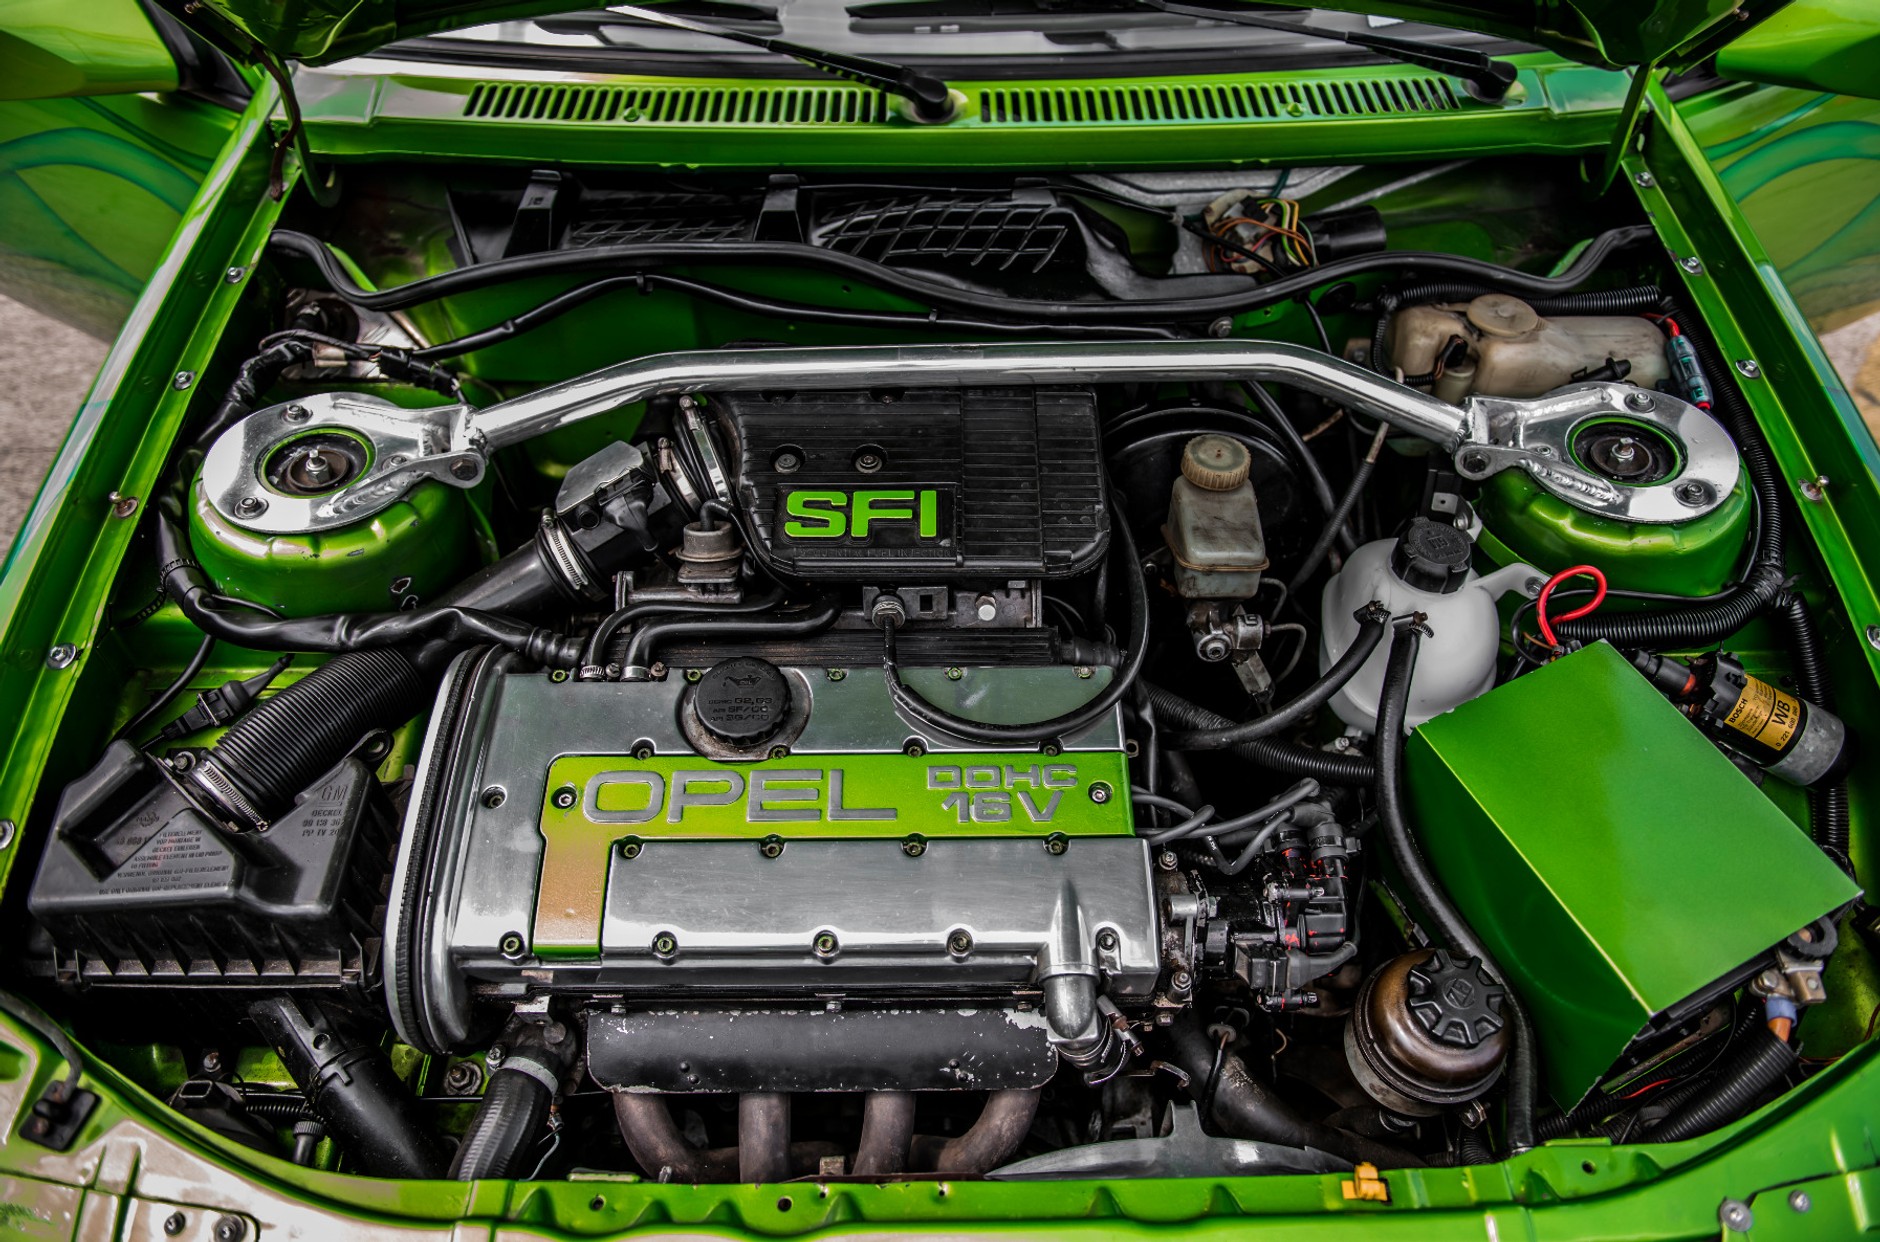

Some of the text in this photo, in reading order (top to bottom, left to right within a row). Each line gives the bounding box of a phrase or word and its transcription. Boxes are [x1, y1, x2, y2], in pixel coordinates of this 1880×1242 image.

[783, 489, 937, 538] SFI
[1728, 698, 1748, 724] BOSCH
[1771, 700, 1790, 726] WB
[1780, 730, 1790, 742] 221
[926, 763, 1080, 790] DOHC
[321, 784, 348, 801] GM
[581, 768, 898, 824] OPEL
[941, 790, 1066, 824] 16V
